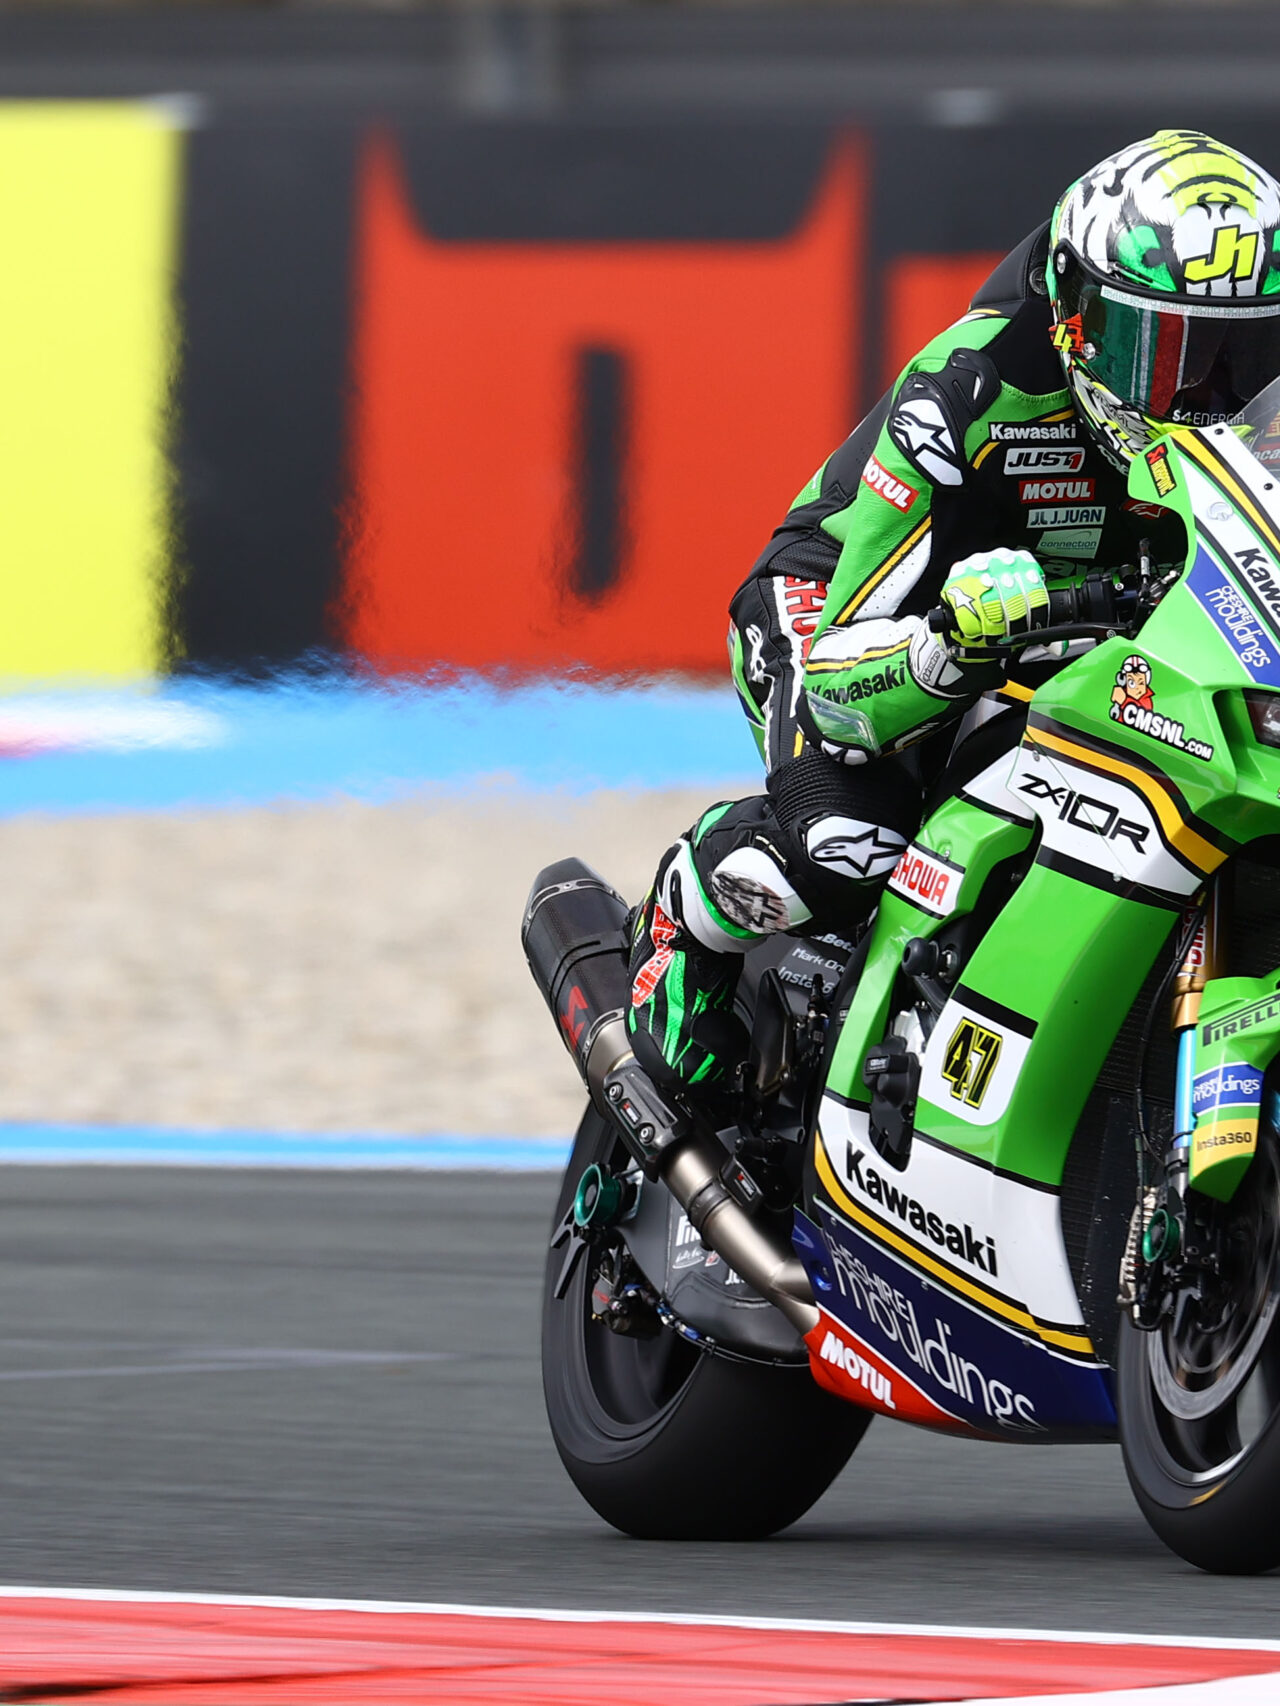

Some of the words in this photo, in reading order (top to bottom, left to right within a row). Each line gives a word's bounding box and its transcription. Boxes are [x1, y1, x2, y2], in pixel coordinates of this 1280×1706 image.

[990, 424, 1077, 440] Kawasaki
[1193, 411, 1245, 425] ENERGIA
[1008, 451, 1083, 470] JUST1
[1022, 482, 1091, 500] MOTUL
[1040, 540, 1097, 549] connection
[1204, 588, 1271, 668] mouldings
[1017, 773, 1150, 855] ZX-10R
[791, 947, 823, 966] Mark
[778, 966, 836, 995] Insta6
[941, 1016, 1003, 1110] 47
[846, 1139, 998, 1277] Kawasaki
[831, 1257, 1049, 1432] mouldings
[820, 1331, 897, 1411] MOTUL
